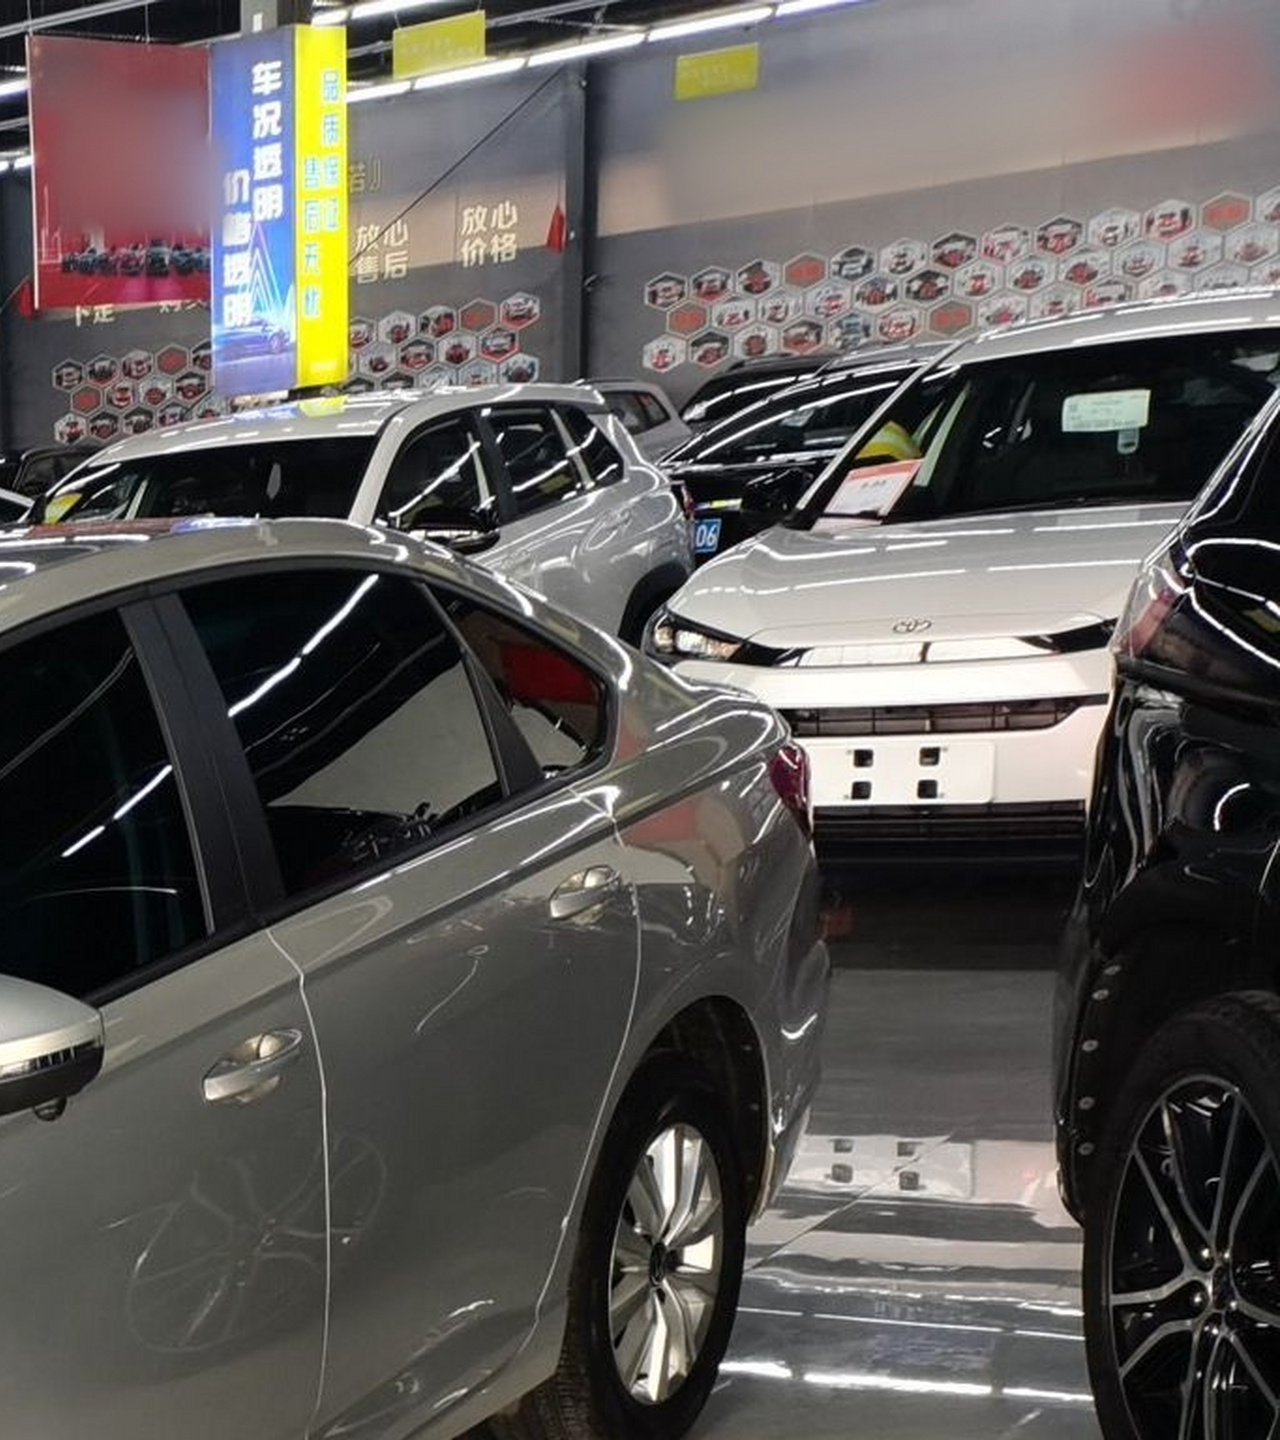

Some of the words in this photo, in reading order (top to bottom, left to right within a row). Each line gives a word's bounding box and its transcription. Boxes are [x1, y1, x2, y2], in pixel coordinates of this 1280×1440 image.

[252, 60, 283, 222] 车况透明
[322, 71, 340, 230] 品质保证
[461, 200, 518, 235] 放心
[222, 168, 253, 329] 价格透明
[304, 157, 321, 319] 售后无忧
[355, 219, 409, 253] 放心
[461, 233, 518, 268] 价格
[356, 251, 409, 284] 售后
[695, 524, 718, 547] 06
